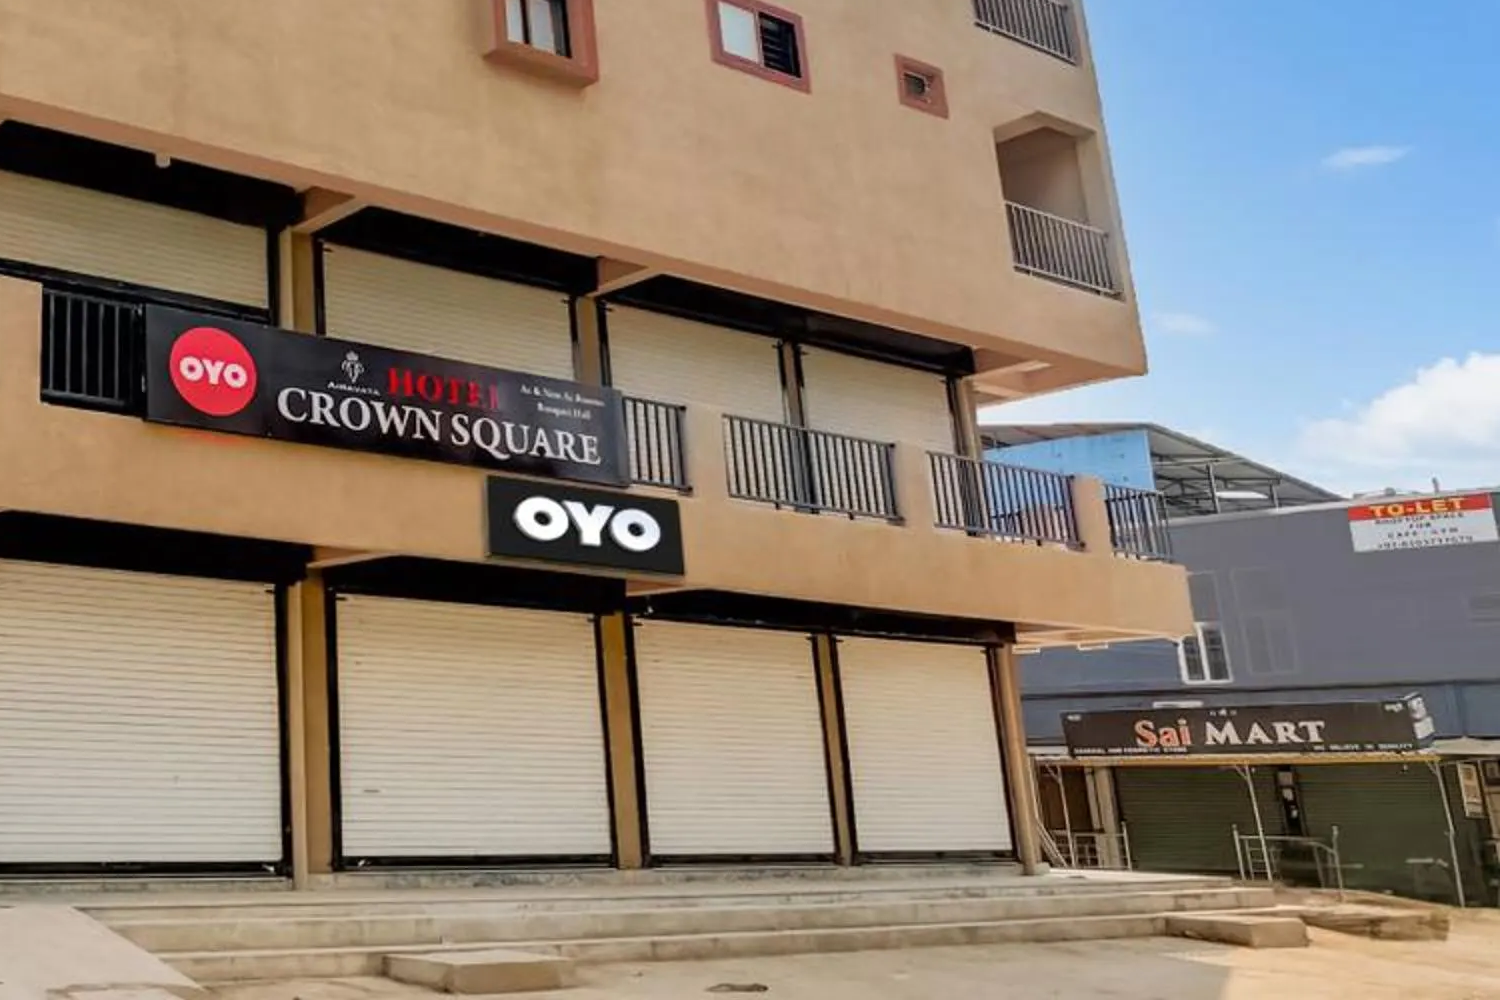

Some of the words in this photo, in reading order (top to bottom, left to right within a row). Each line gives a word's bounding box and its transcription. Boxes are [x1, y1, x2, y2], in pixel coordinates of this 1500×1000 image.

[179, 356, 248, 389] OYO
[388, 367, 499, 410] HOTEL
[277, 386, 442, 442] CROWN
[451, 413, 601, 466] SQUARE
[514, 496, 662, 552] OYO
[1369, 497, 1465, 517] TO-LET
[1134, 718, 1193, 748] Sai
[1204, 719, 1325, 746] MART
